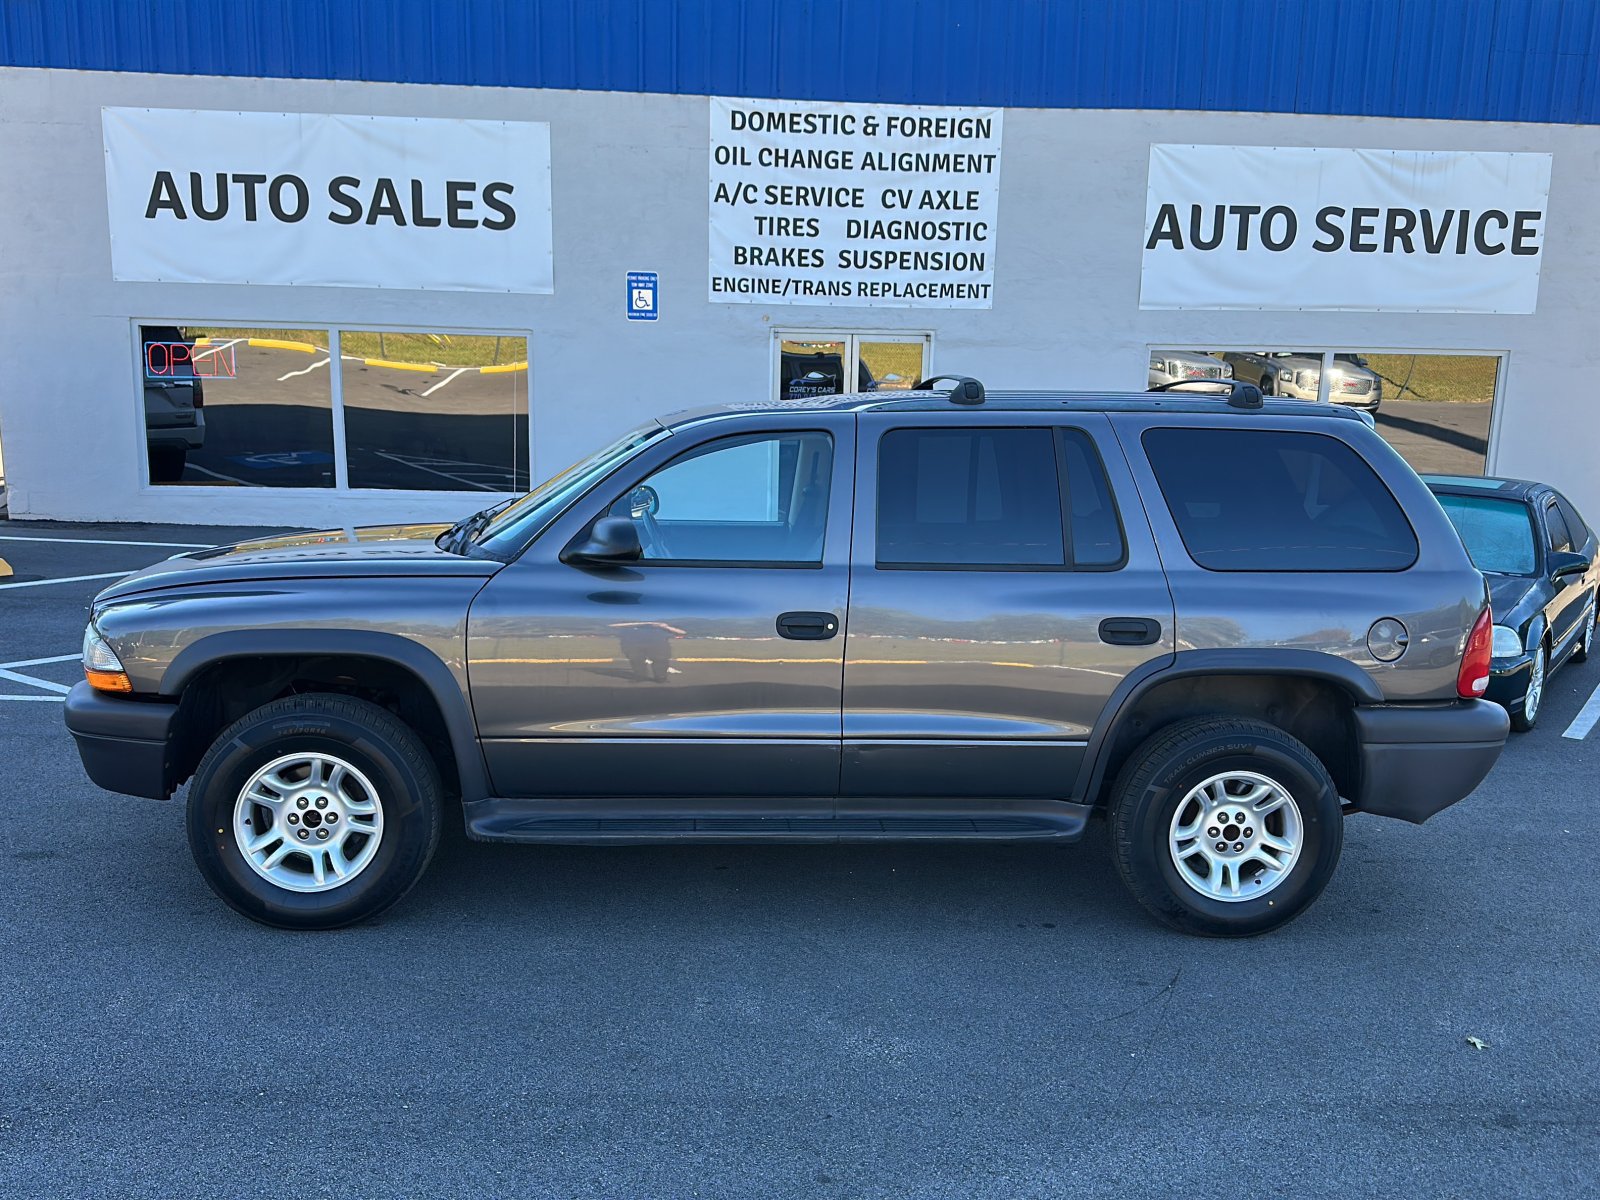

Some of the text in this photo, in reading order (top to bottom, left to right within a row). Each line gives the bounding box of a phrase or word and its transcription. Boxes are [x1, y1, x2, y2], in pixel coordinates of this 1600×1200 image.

[731, 110, 992, 139] DOMESTIC & FOREIGN
[714, 145, 997, 174] OIL CHANGE ALIGNMENT
[144, 170, 517, 231] AUTO SALES
[713, 181, 980, 211] A/C SERVICE CV AXLE
[753, 216, 988, 242] TIRES DIAGNOSTIC
[1145, 203, 1542, 256] AUTO SERVICE
[734, 245, 985, 272] BRAKES SUSPENSION
[712, 276, 992, 299] ENGINE/TRANS REPLACEMENT
[148, 343, 235, 377] OPEN
[1163, 764, 1186, 784] TRAIL
[1186, 745, 1225, 765] CLIMBER
